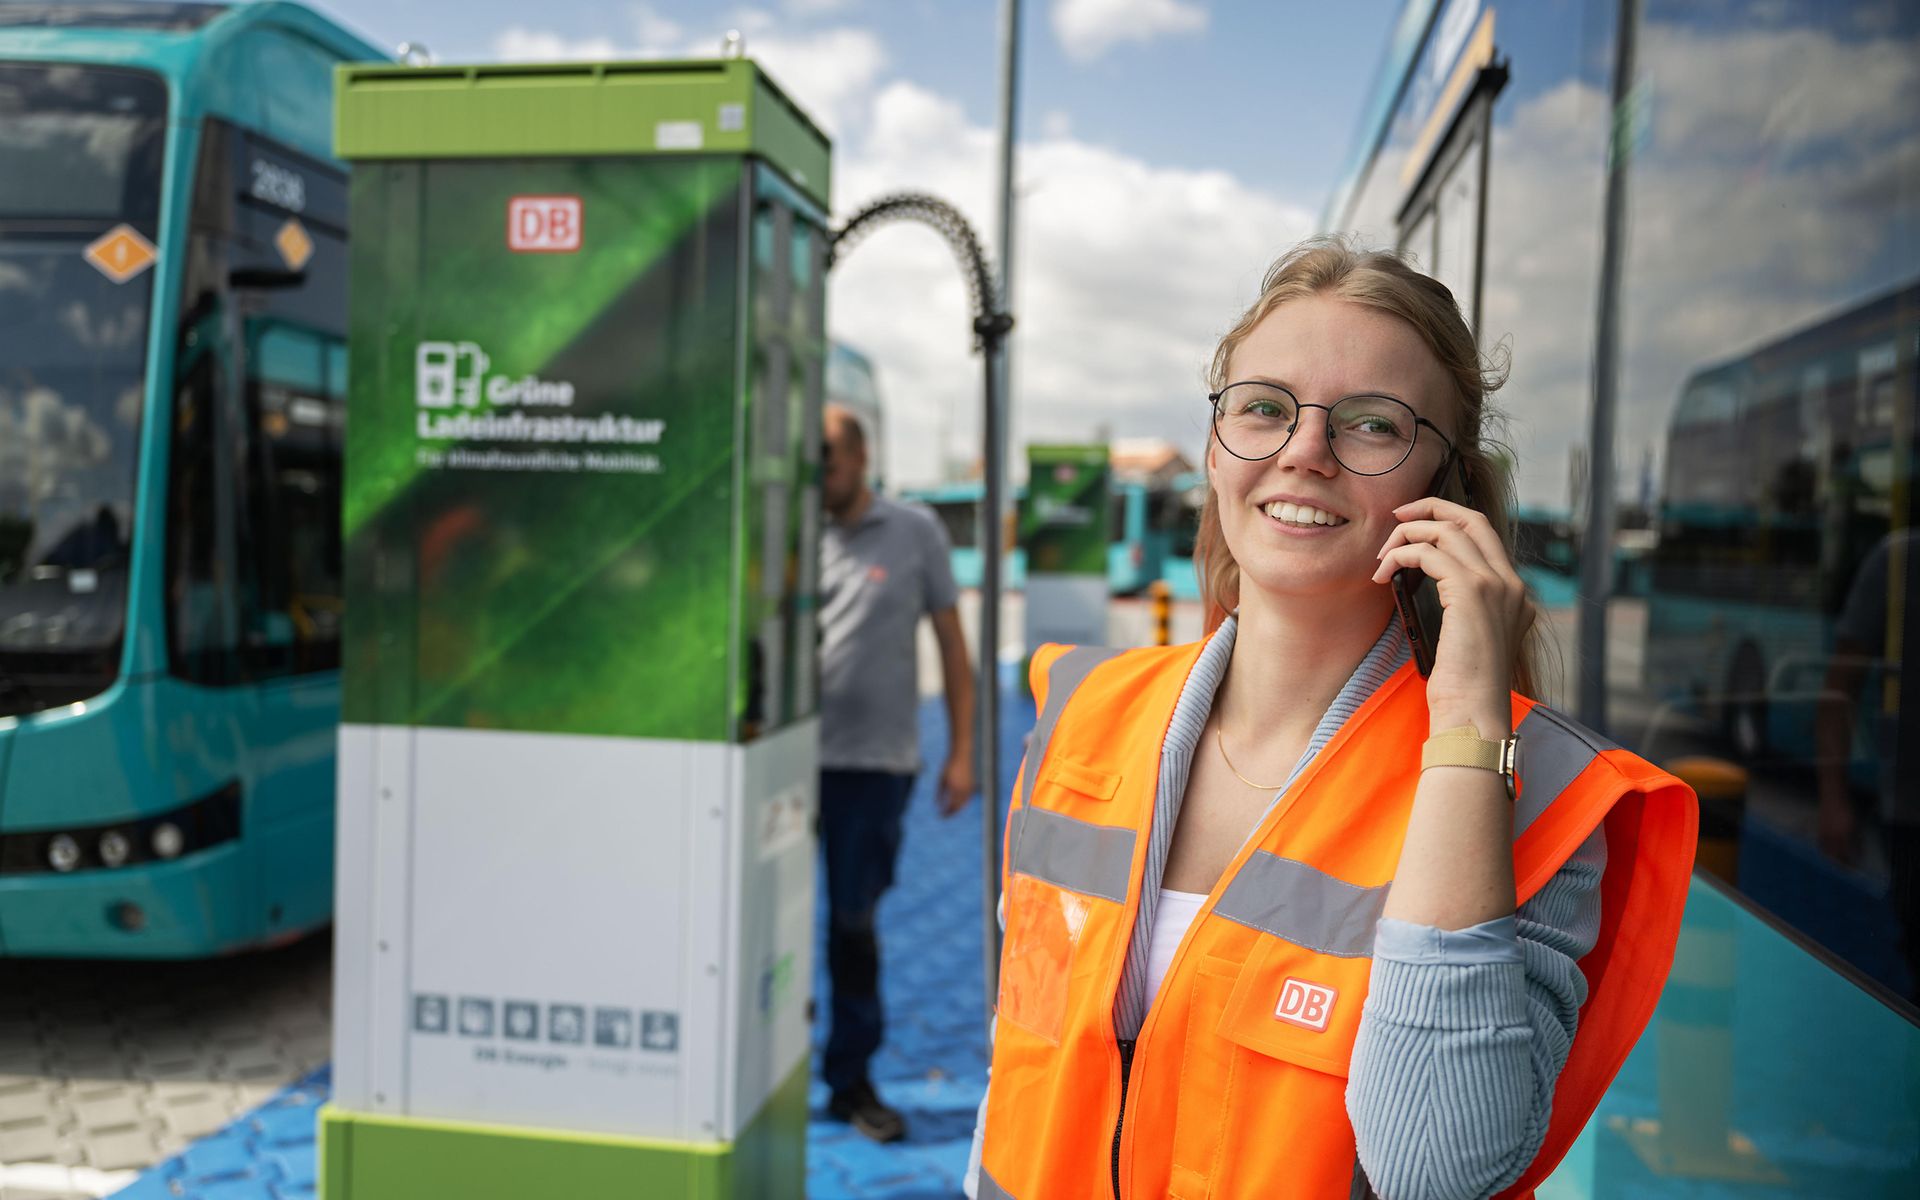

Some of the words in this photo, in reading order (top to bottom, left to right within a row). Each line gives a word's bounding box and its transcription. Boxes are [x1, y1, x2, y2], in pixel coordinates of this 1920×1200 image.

[521, 207, 571, 242] DB
[487, 375, 575, 406] Grüne
[417, 411, 665, 443] Ladeinfrastruktur
[1280, 983, 1327, 1022] DB
